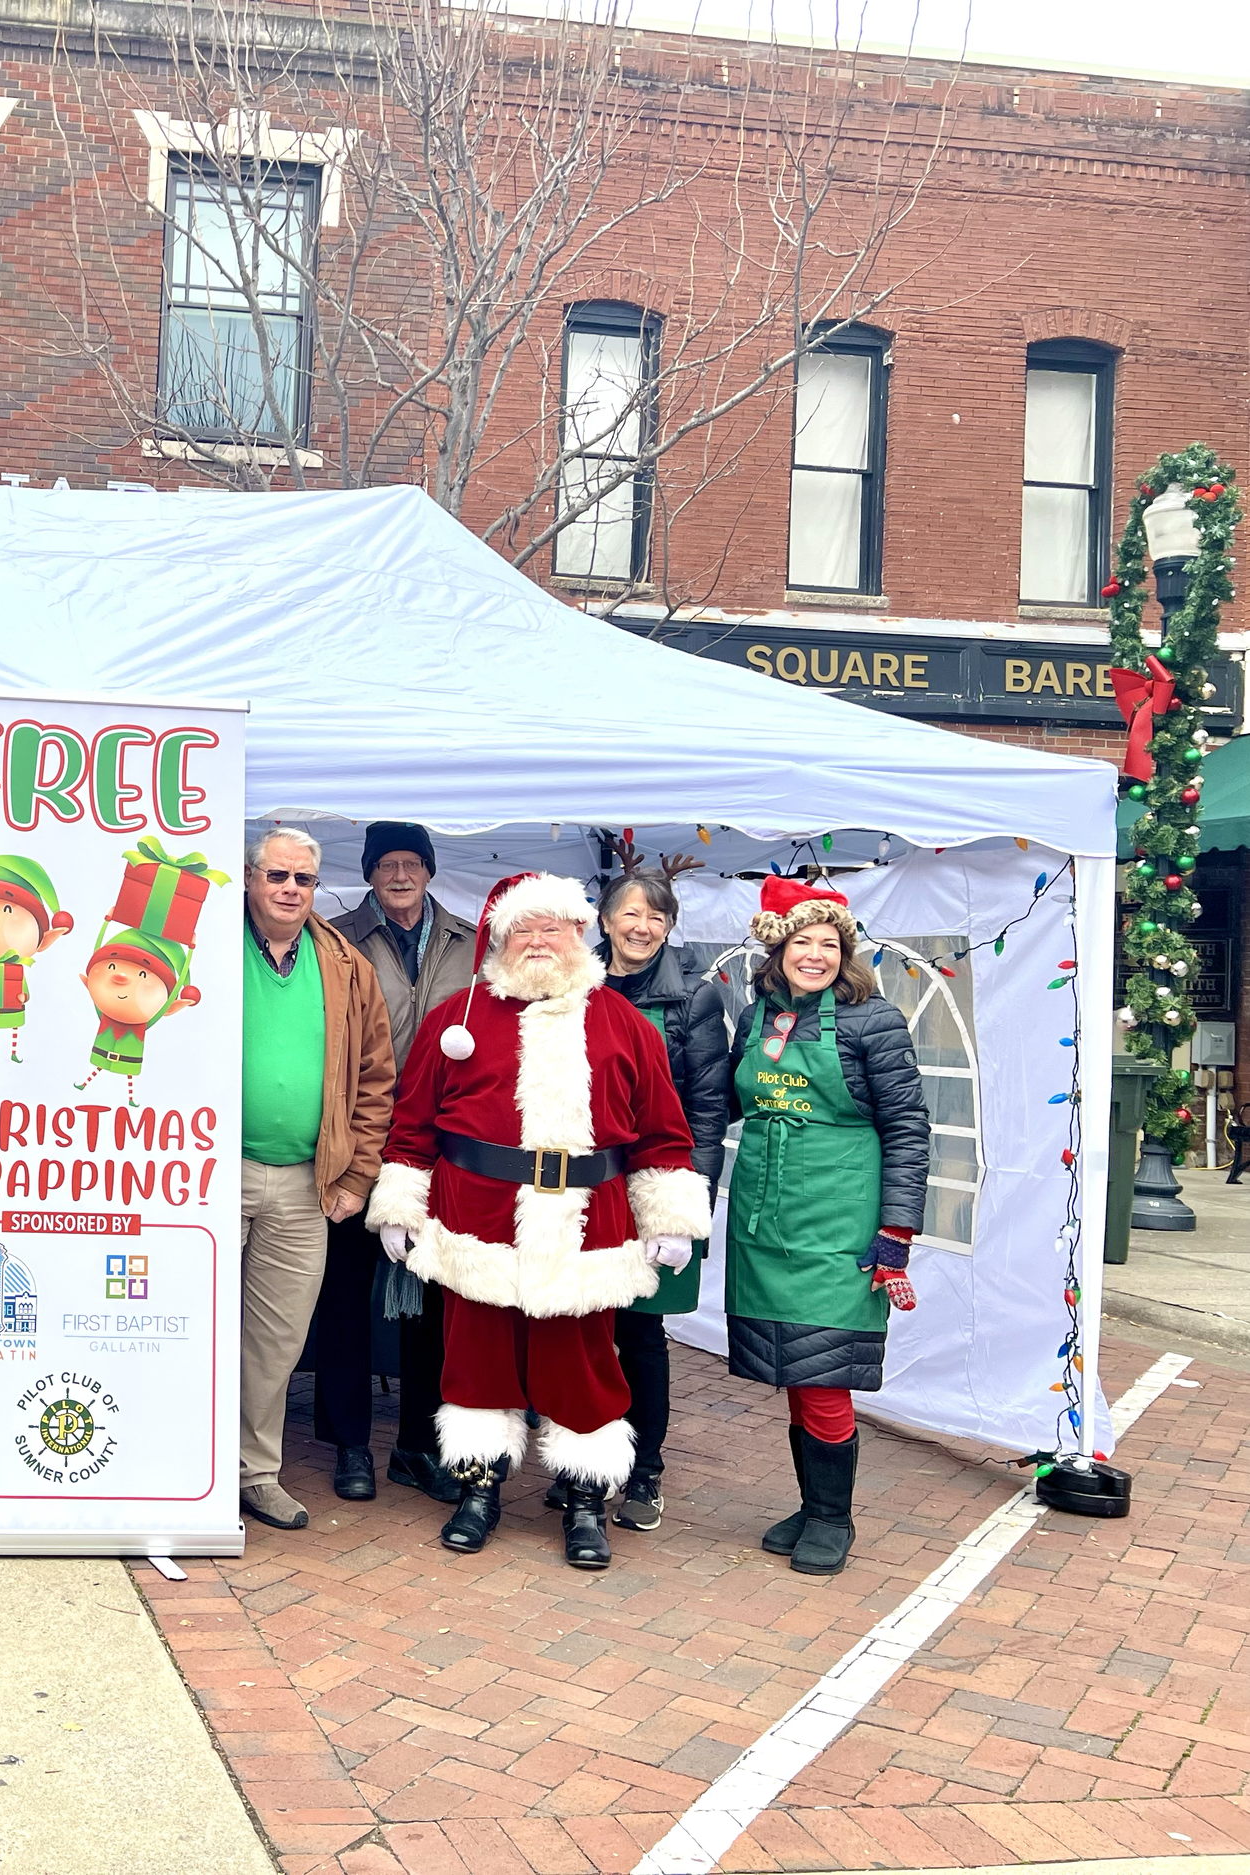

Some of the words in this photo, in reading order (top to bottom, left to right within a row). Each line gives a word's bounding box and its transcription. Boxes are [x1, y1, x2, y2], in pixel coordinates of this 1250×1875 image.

[746, 644, 930, 688] SQUARE
[757, 1071, 780, 1085] Pilot
[781, 1073, 809, 1088] Club
[772, 1087, 788, 1099] of
[754, 1095, 791, 1110] Sumner
[793, 1098, 813, 1113] Co.
[10, 1213, 108, 1232] SPONSORED
[112, 1216, 132, 1233] BY
[63, 1314, 112, 1331] FIRST
[116, 1315, 190, 1333] BAPTIST
[89, 1341, 160, 1353] GALLATIN
[16, 1374, 54, 1411] PILOT
[61, 1371, 102, 1394] CLUB
[102, 1394, 120, 1413] OF
[41, 1400, 93, 1424] PILOT
[41, 1428, 93, 1453] INTERNATIONAL
[15, 1435, 64, 1484] SUMNER
[69, 1436, 118, 1484] COUNTY
